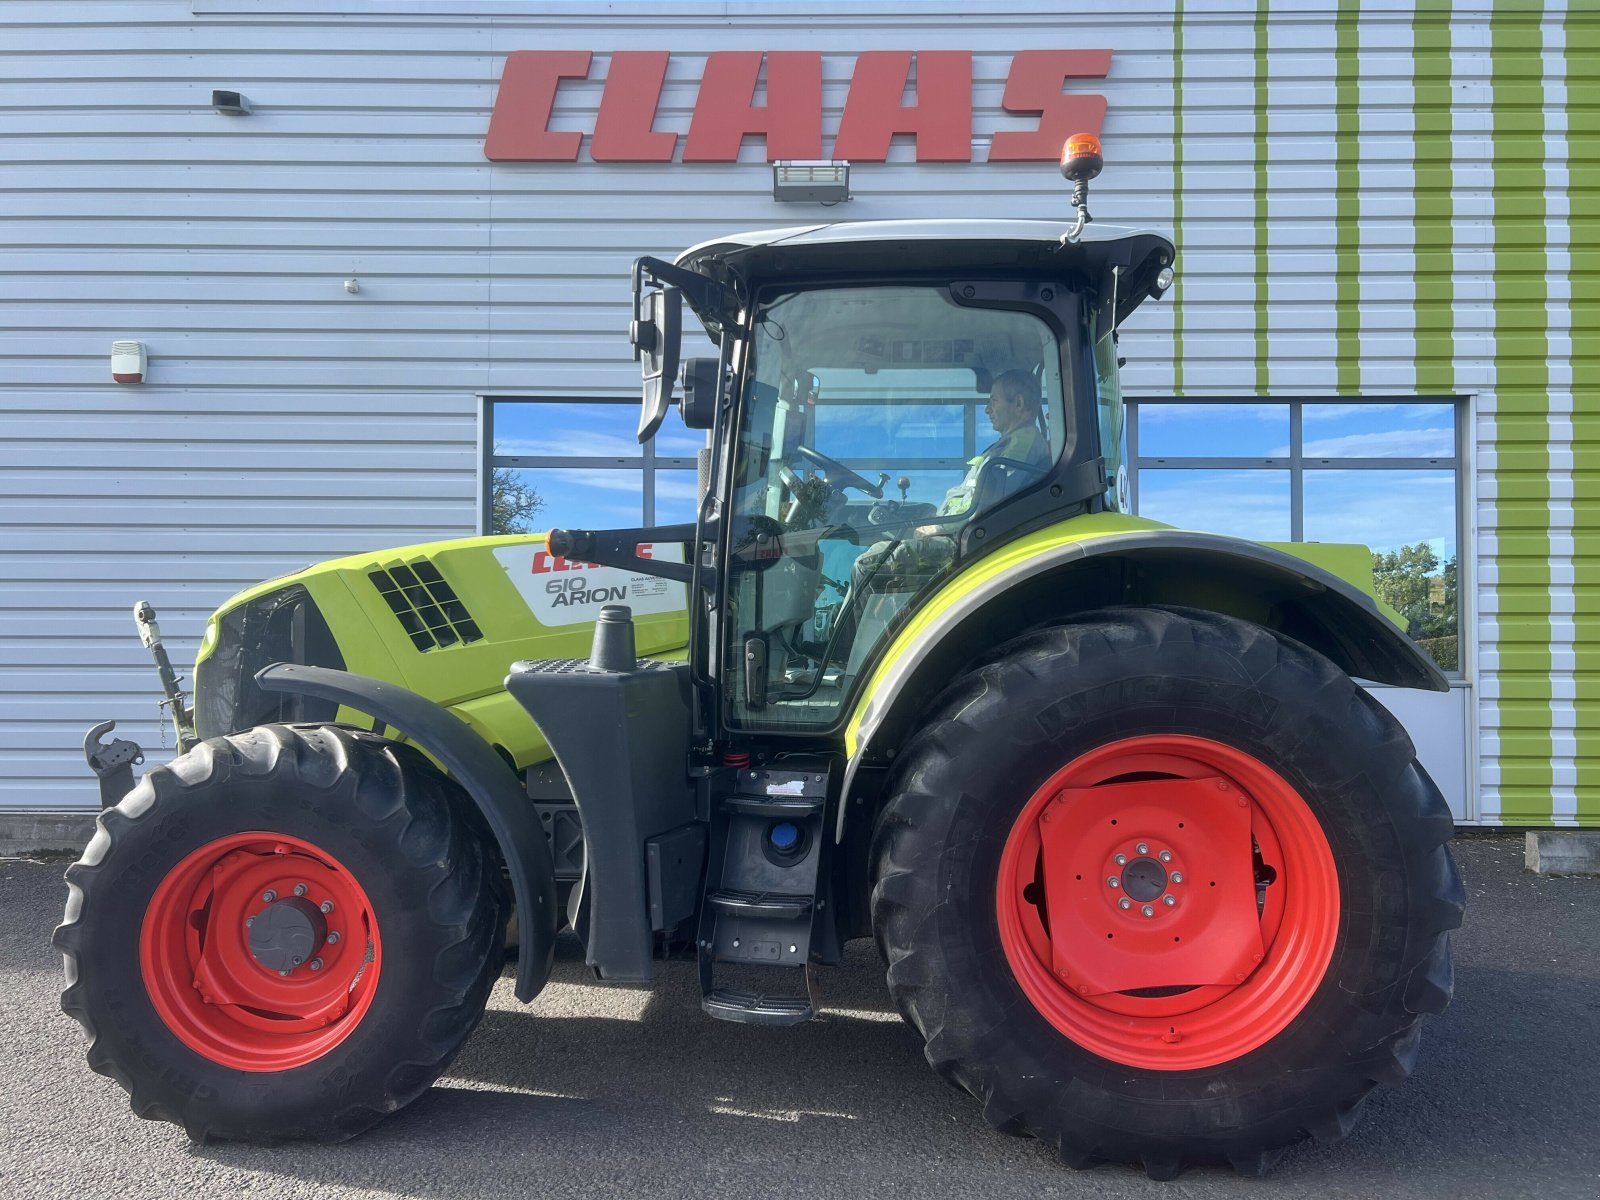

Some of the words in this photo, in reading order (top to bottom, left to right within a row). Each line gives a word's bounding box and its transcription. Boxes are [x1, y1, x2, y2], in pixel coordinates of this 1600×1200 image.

[484, 49, 1114, 163] CLAAS
[531, 543, 653, 574] CLS
[545, 576, 587, 594] 610
[551, 585, 627, 608] ARION
